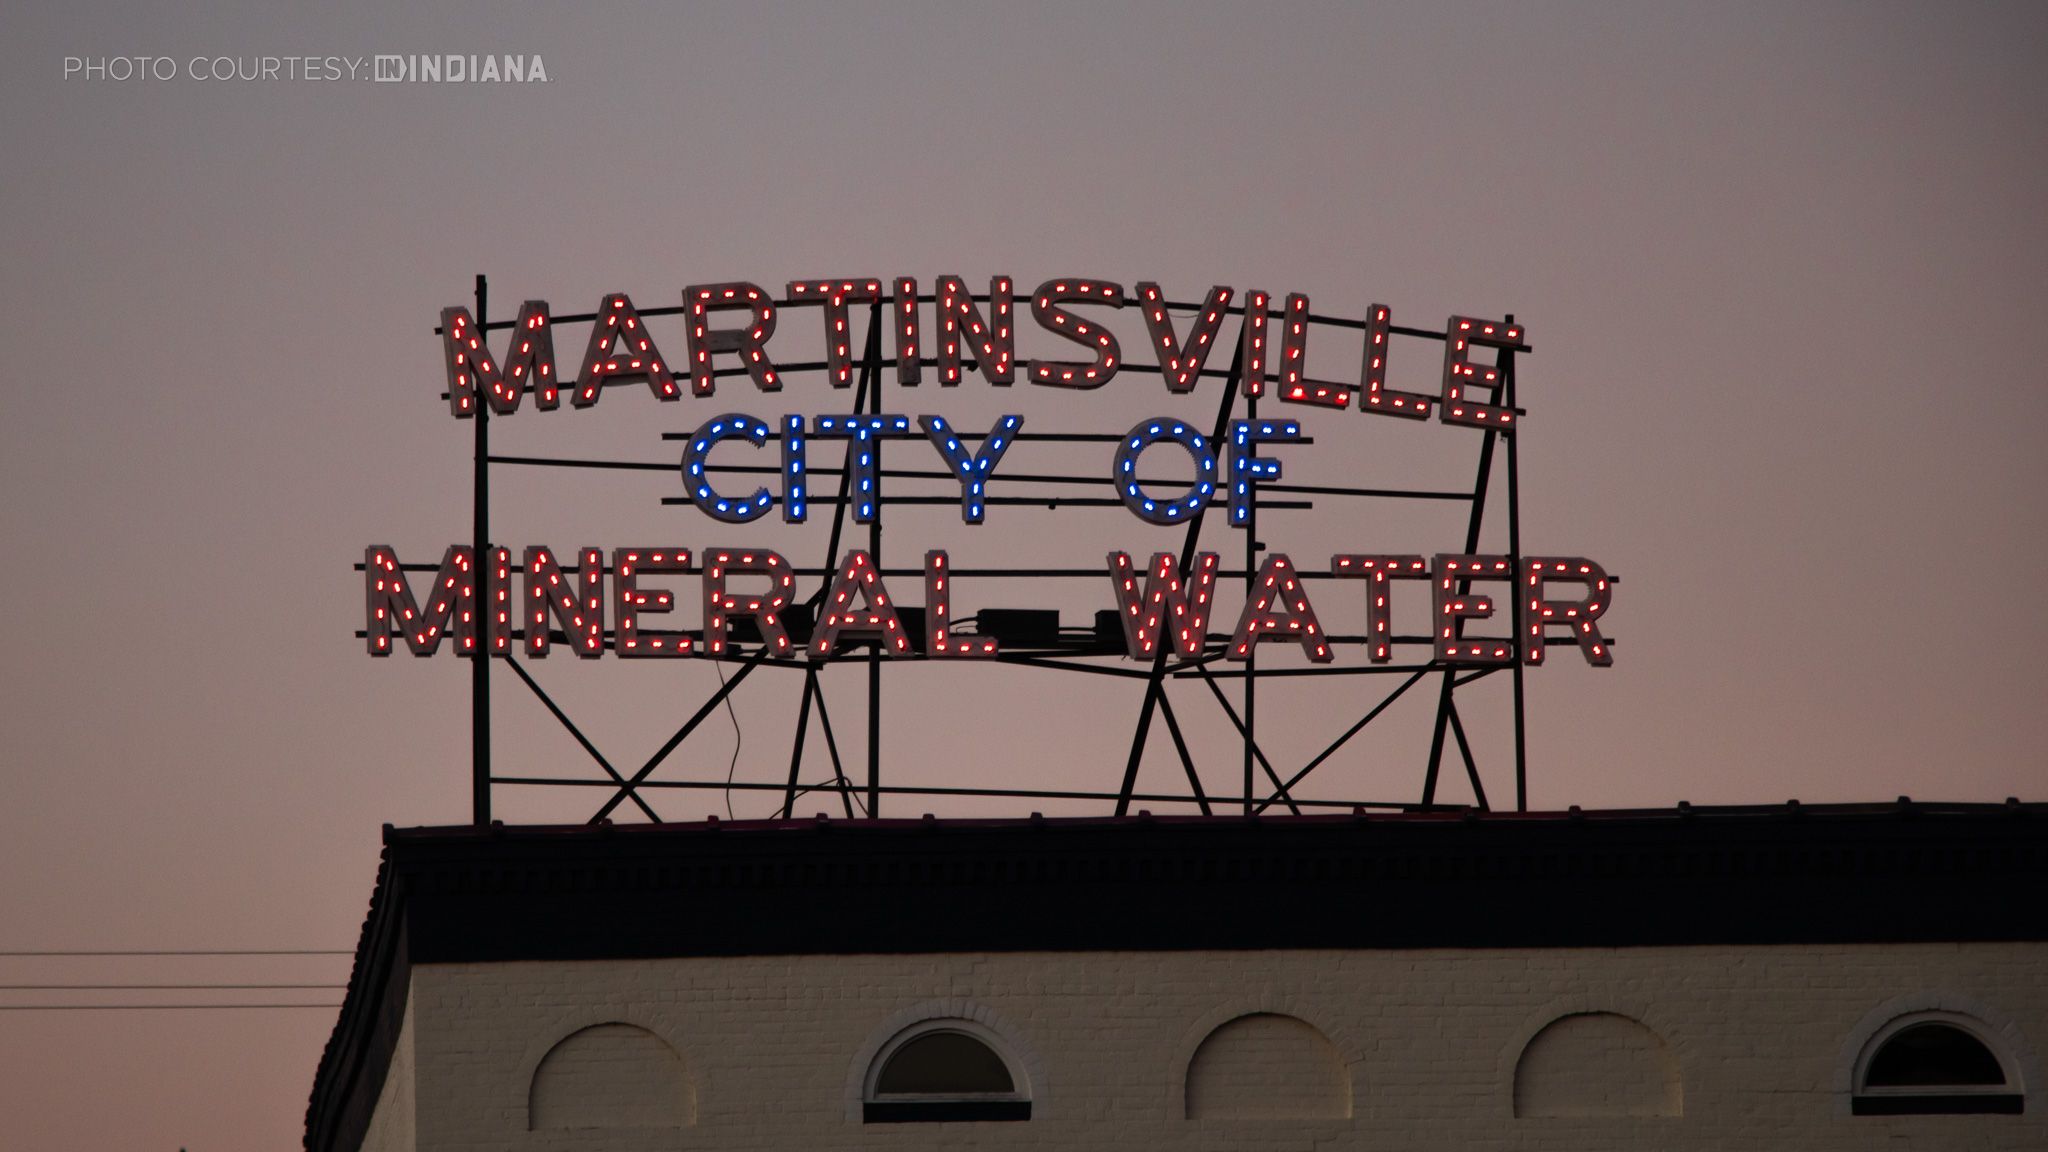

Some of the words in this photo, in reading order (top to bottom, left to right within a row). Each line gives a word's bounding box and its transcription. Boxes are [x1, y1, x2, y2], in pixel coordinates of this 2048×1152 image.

[440, 275, 1525, 430] MARTINSVILLE
[681, 412, 1024, 524] CITY
[1113, 416, 1301, 527] OF
[365, 544, 999, 659] MINERAL
[1106, 551, 1613, 666] WATER
